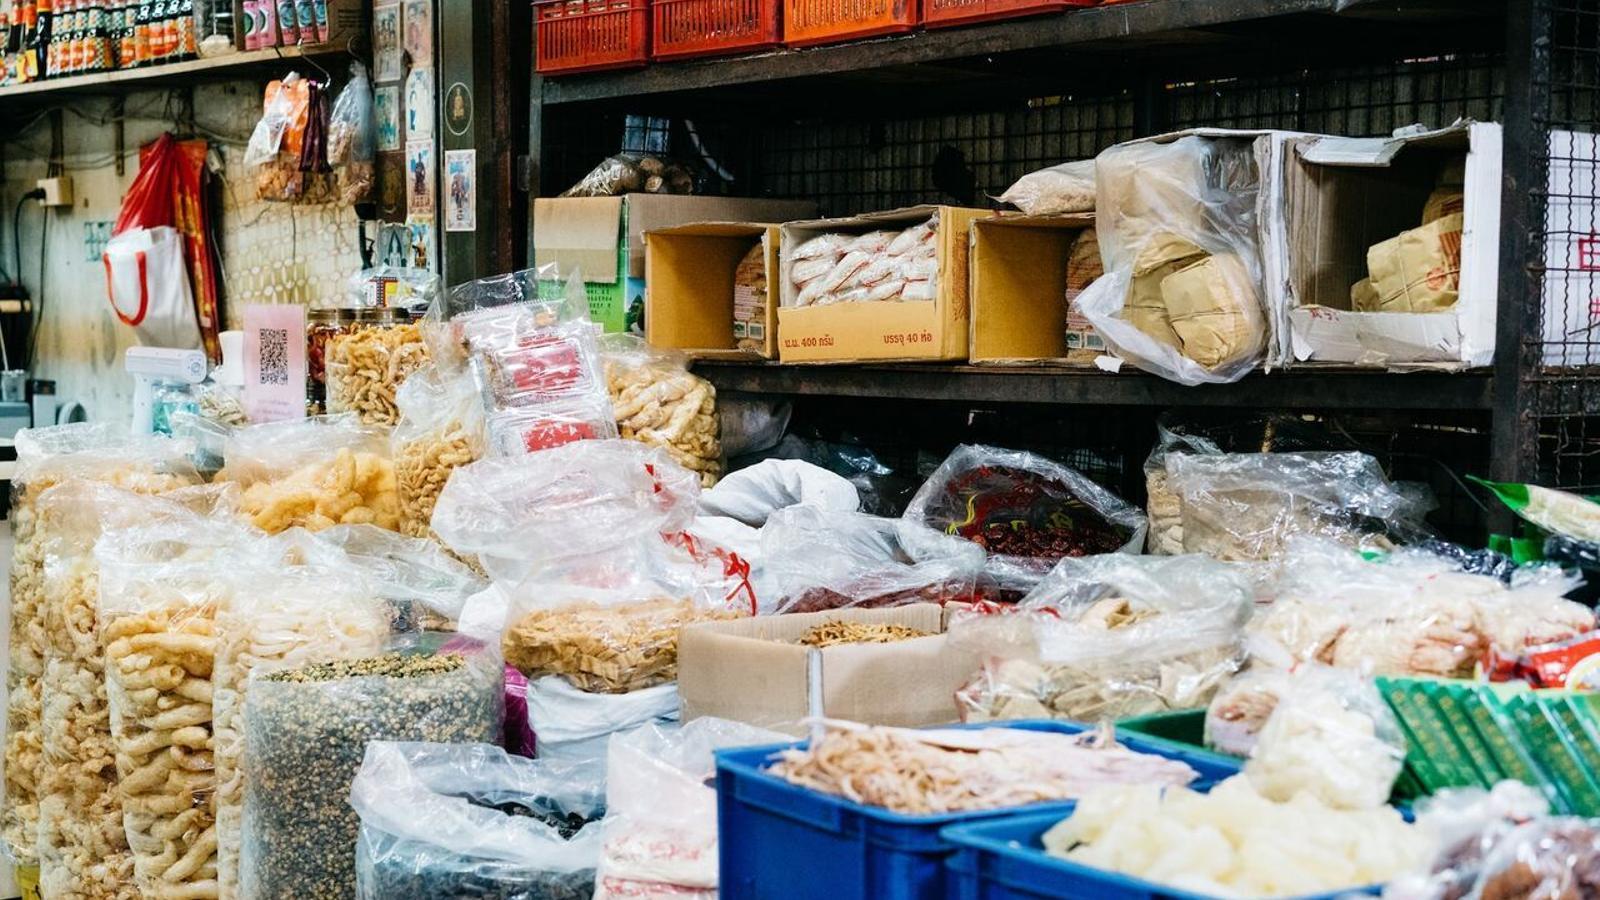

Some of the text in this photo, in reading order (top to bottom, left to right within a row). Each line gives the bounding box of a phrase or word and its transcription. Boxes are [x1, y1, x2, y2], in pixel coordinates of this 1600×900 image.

[801, 337, 817, 347] 400
[819, 334, 835, 347] กรัม
[883, 329, 933, 346] บรรจุ 40 ห่อ
